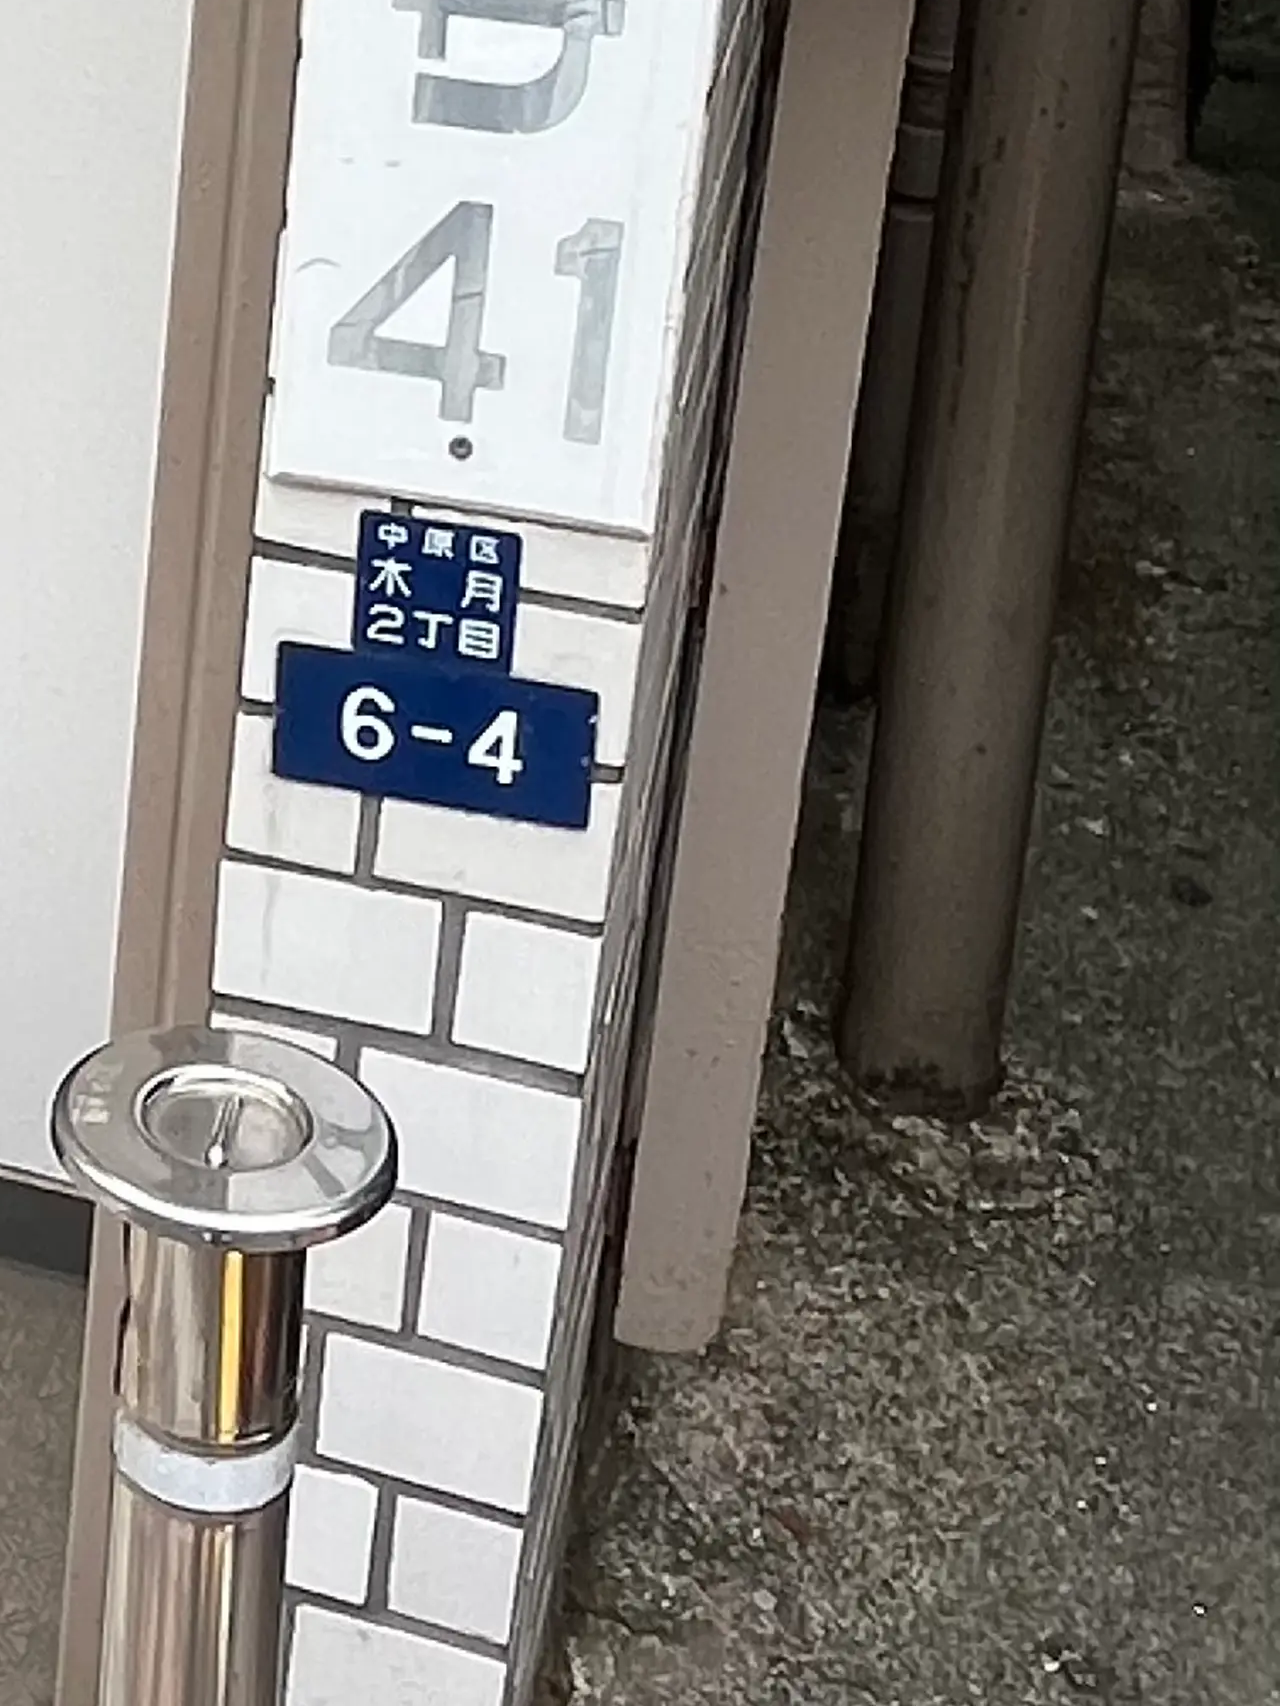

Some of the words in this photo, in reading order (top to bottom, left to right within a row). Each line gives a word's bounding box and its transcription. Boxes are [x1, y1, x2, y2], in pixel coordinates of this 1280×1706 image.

[378, 522, 500, 565] 中原区
[366, 603, 501, 660] 2丁目
[339, 684, 524, 786] 6-4
